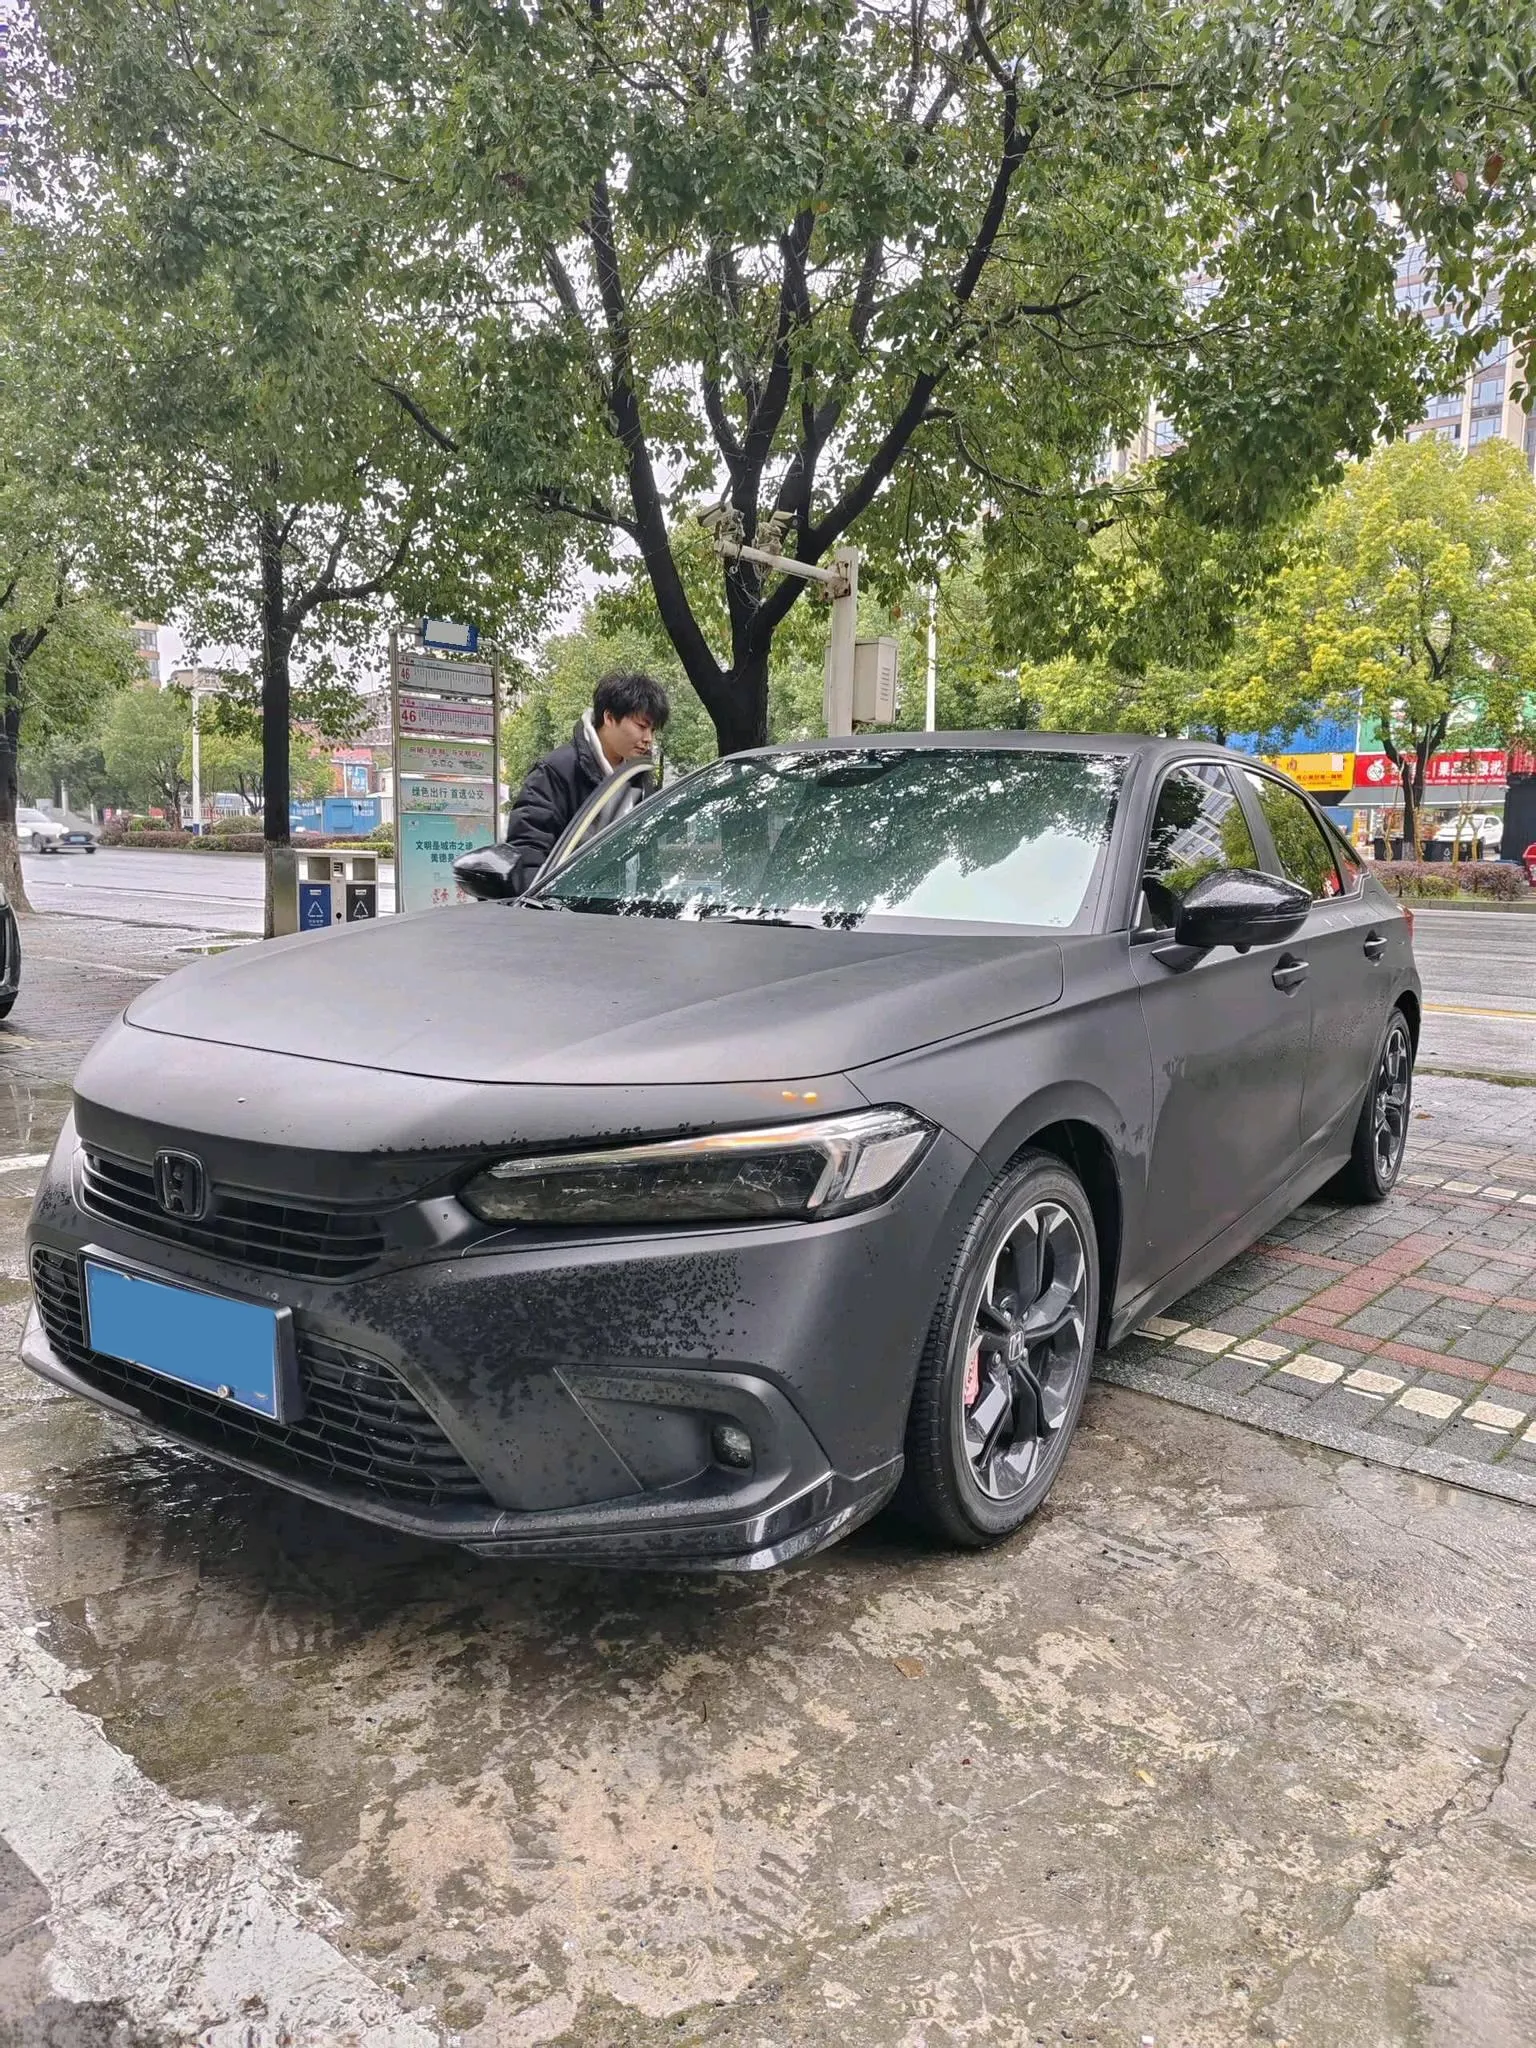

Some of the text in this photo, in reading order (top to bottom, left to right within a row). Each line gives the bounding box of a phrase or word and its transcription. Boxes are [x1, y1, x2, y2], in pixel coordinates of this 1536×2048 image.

[401, 668, 410, 680] 46
[401, 709, 416, 723] 46
[411, 785, 448, 798] 绿色出行
